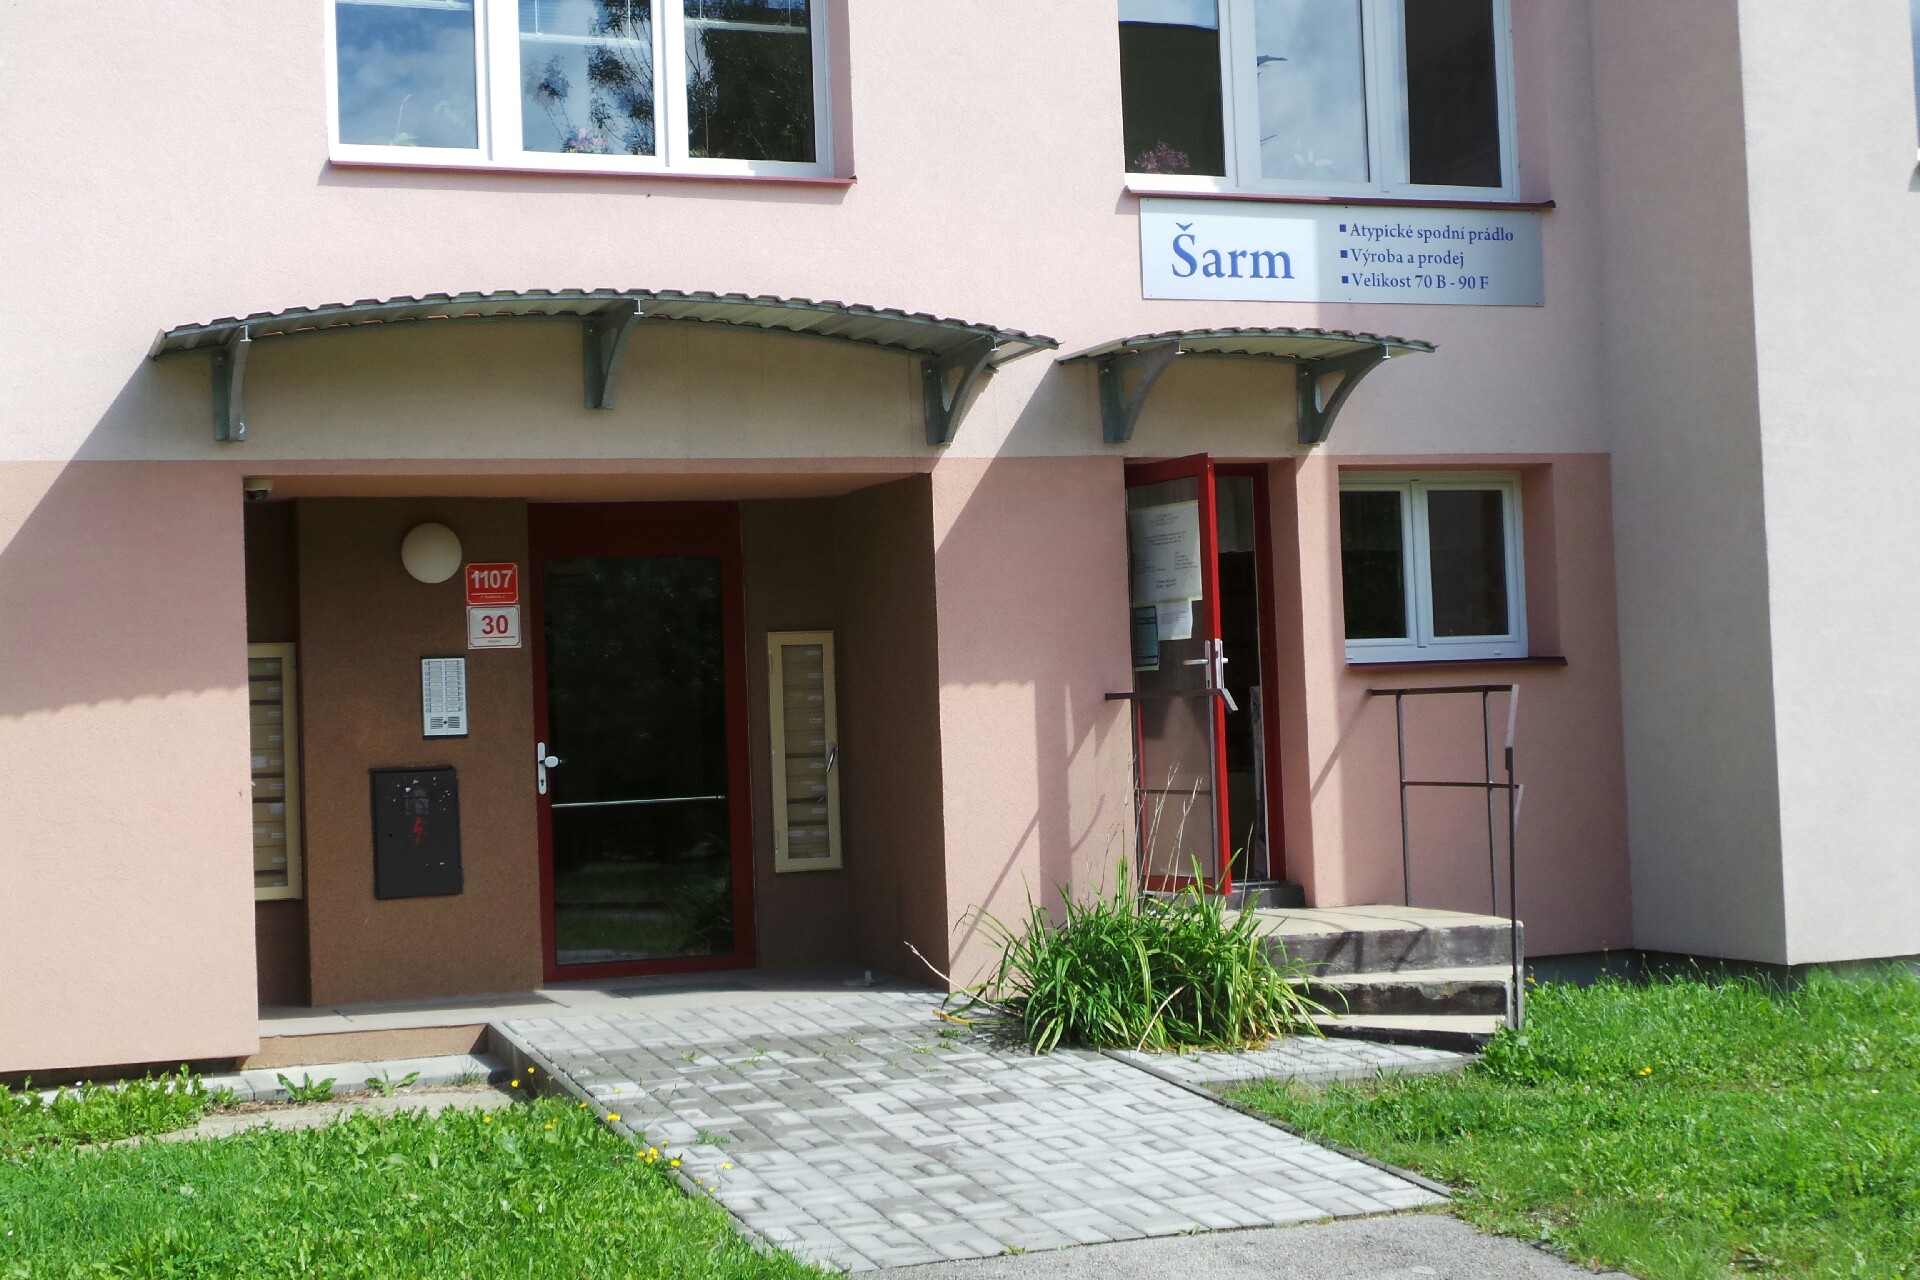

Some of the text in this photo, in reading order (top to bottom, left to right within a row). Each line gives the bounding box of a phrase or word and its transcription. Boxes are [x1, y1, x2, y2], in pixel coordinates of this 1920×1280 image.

[1350, 223, 1514, 245] Atypické spodní prádlo
[1171, 222, 1295, 279] Šarm
[1351, 248, 1465, 270] Výroba a prodej
[1352, 273, 1412, 289] Velikost
[1414, 274, 1433, 289] 70
[1436, 274, 1447, 289] B
[1458, 275, 1477, 290] 90
[1479, 275, 1489, 290] F
[471, 570, 513, 589] 1107
[482, 615, 509, 634] 30
